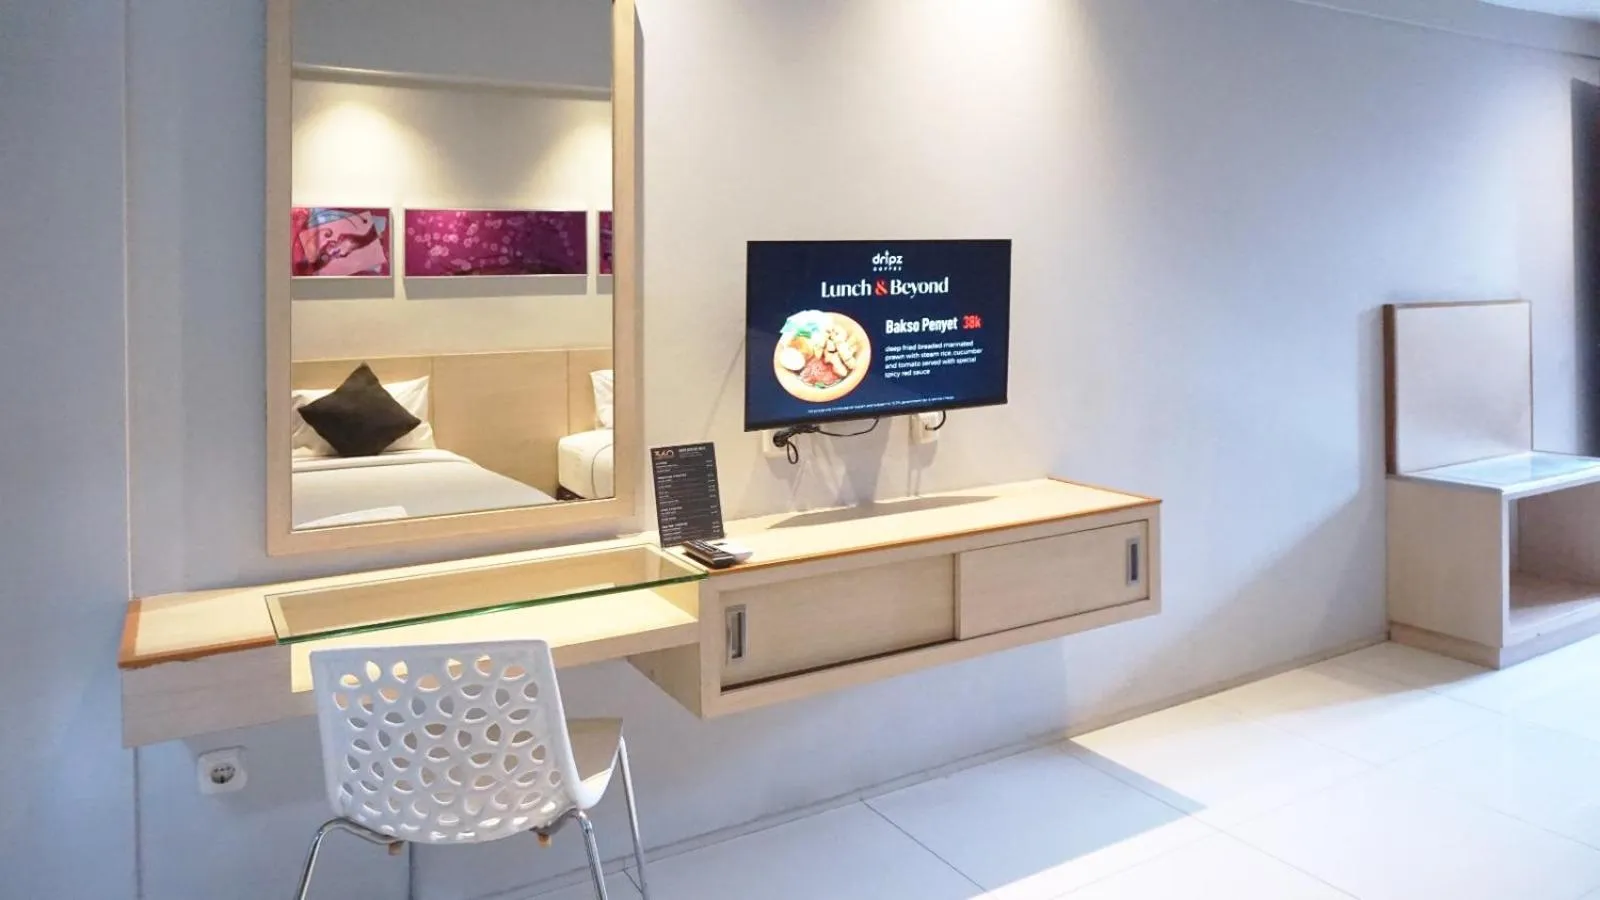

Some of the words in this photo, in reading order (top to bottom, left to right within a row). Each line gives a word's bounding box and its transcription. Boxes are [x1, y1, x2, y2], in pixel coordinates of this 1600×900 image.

[872, 250, 903, 266] dripz
[821, 279, 871, 298] Lunch
[875, 280, 888, 295] &
[890, 277, 949, 299] Beyond
[886, 319, 920, 334] Bakso
[922, 317, 958, 333] Penyet
[918, 342, 942, 350] breaded
[943, 340, 974, 348] marinated
[953, 348, 983, 356] cucumber
